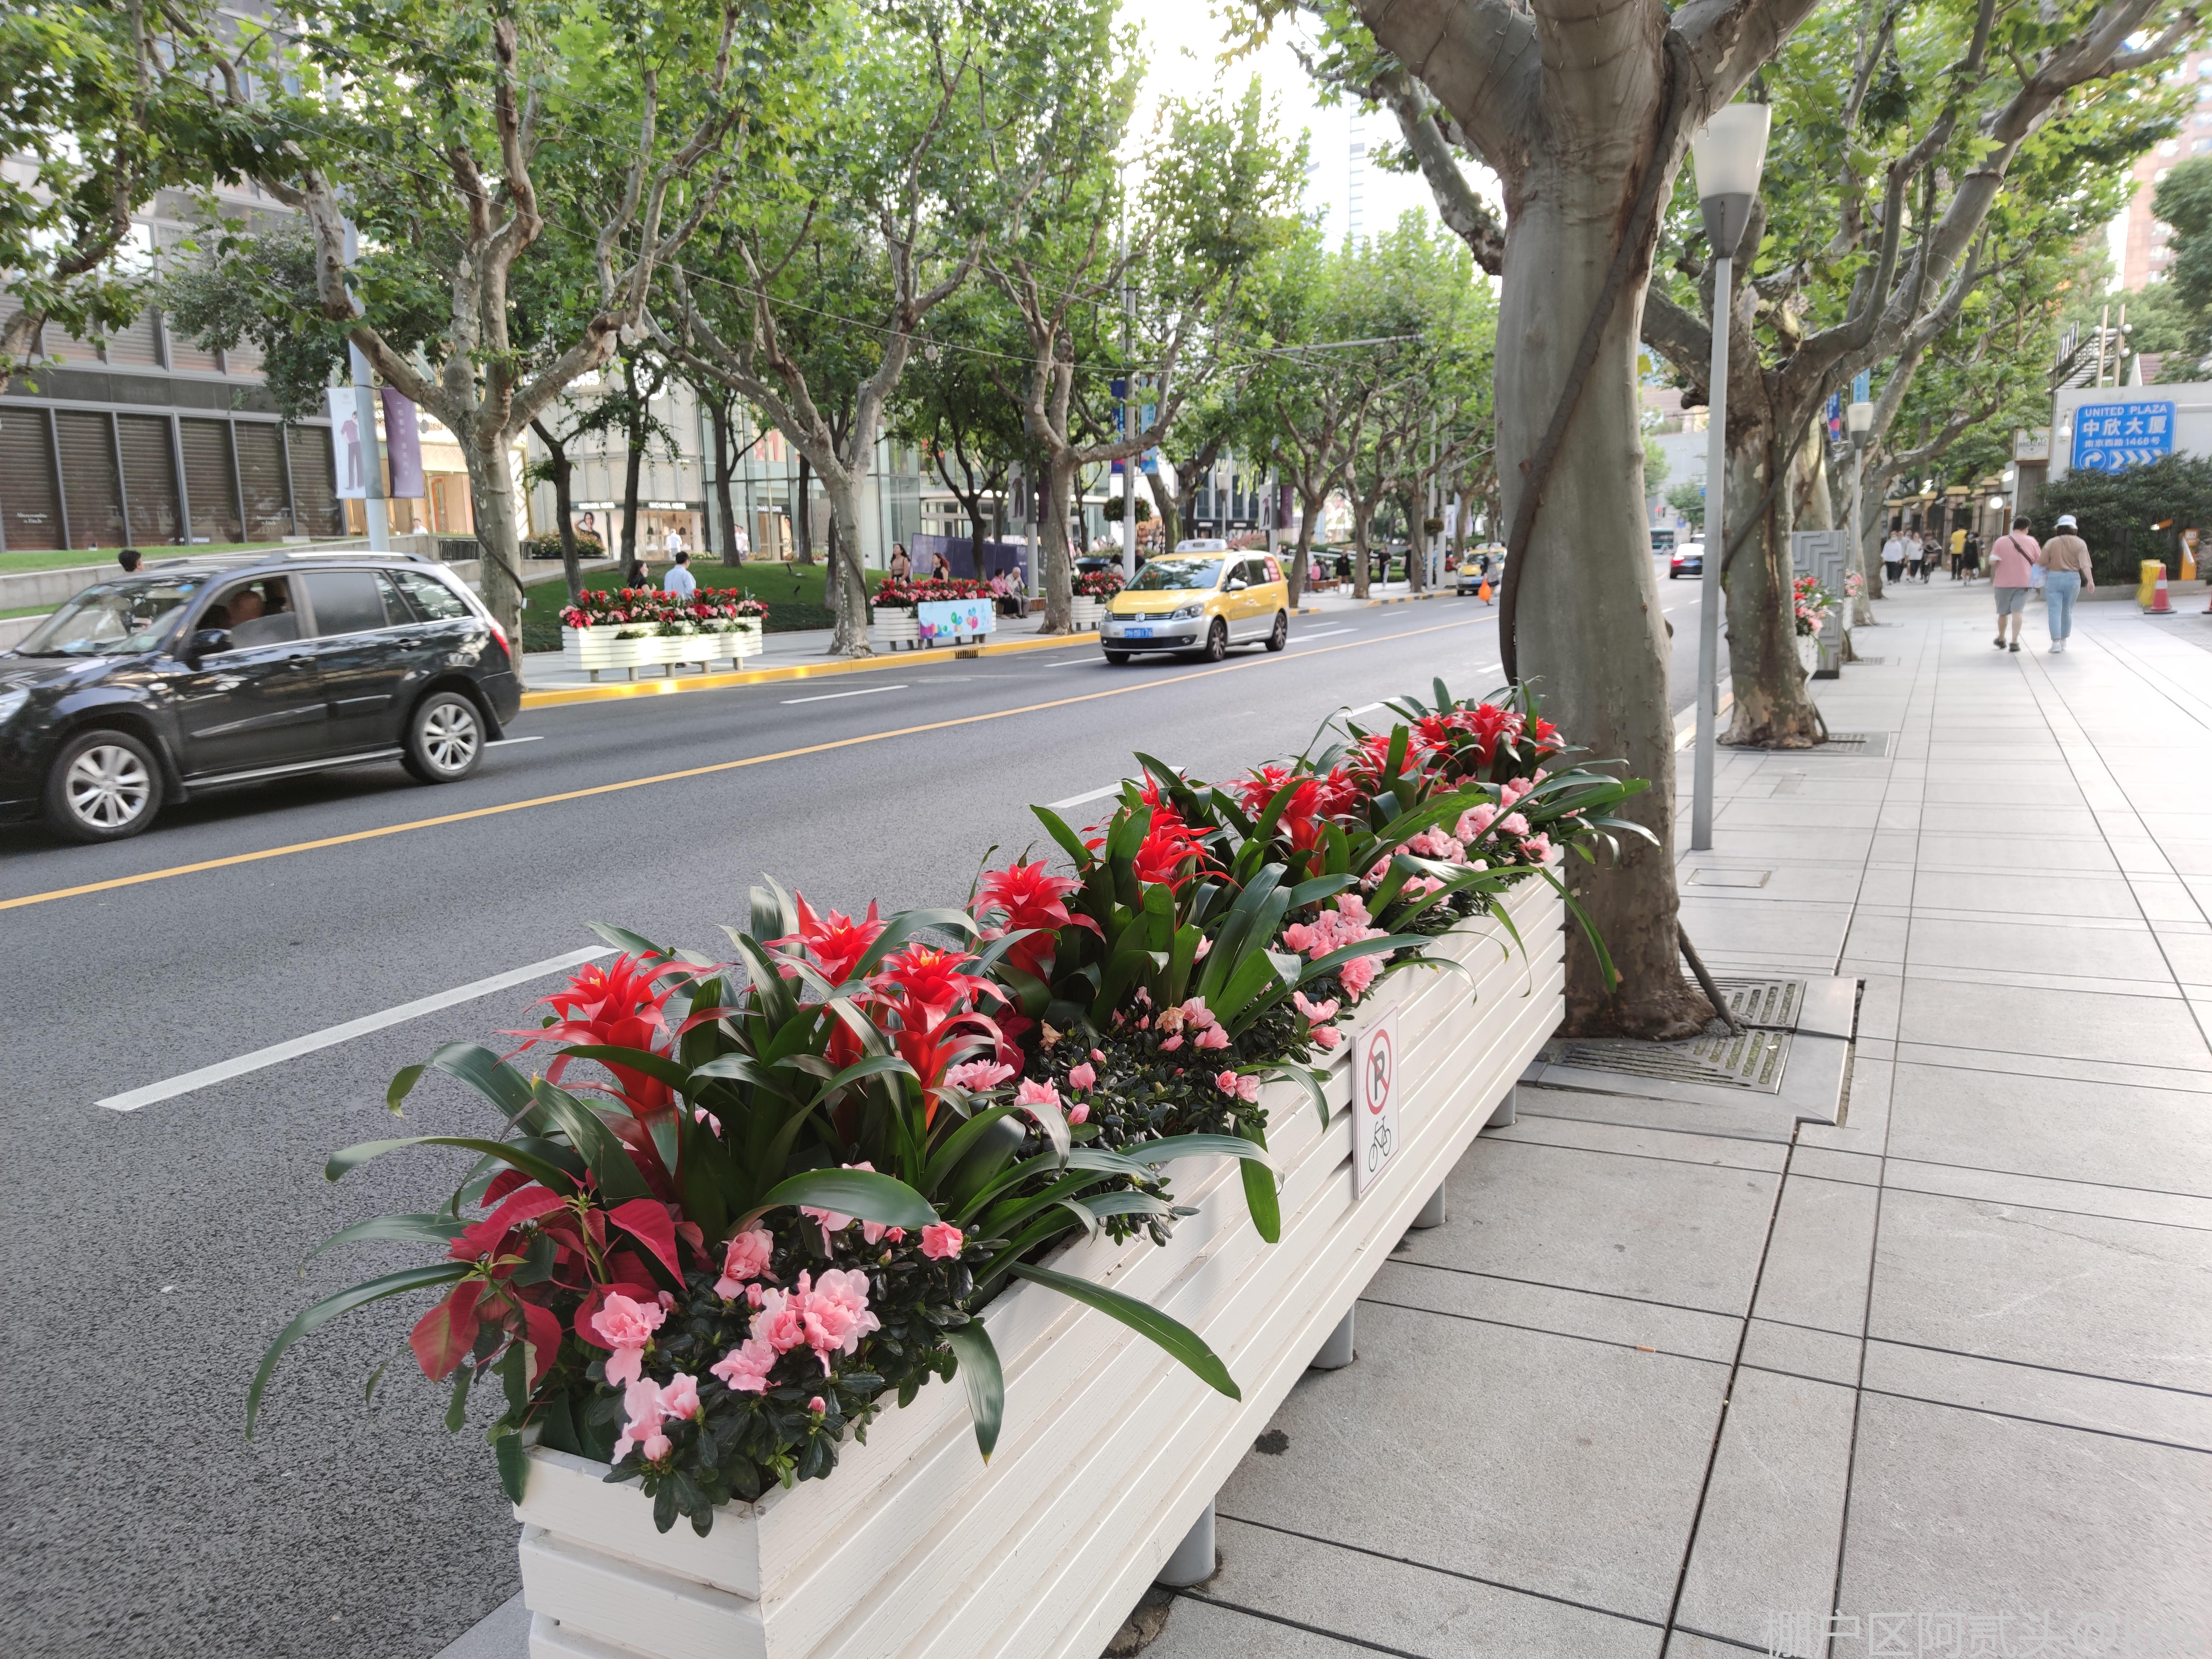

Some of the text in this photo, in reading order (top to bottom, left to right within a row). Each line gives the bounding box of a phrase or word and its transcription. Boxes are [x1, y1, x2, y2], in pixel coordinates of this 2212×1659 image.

[2085, 404, 2167, 417] UNITED PLAZA
[2083, 415, 2168, 437] 中欣大厦
[1374, 1050, 1385, 1101] P
